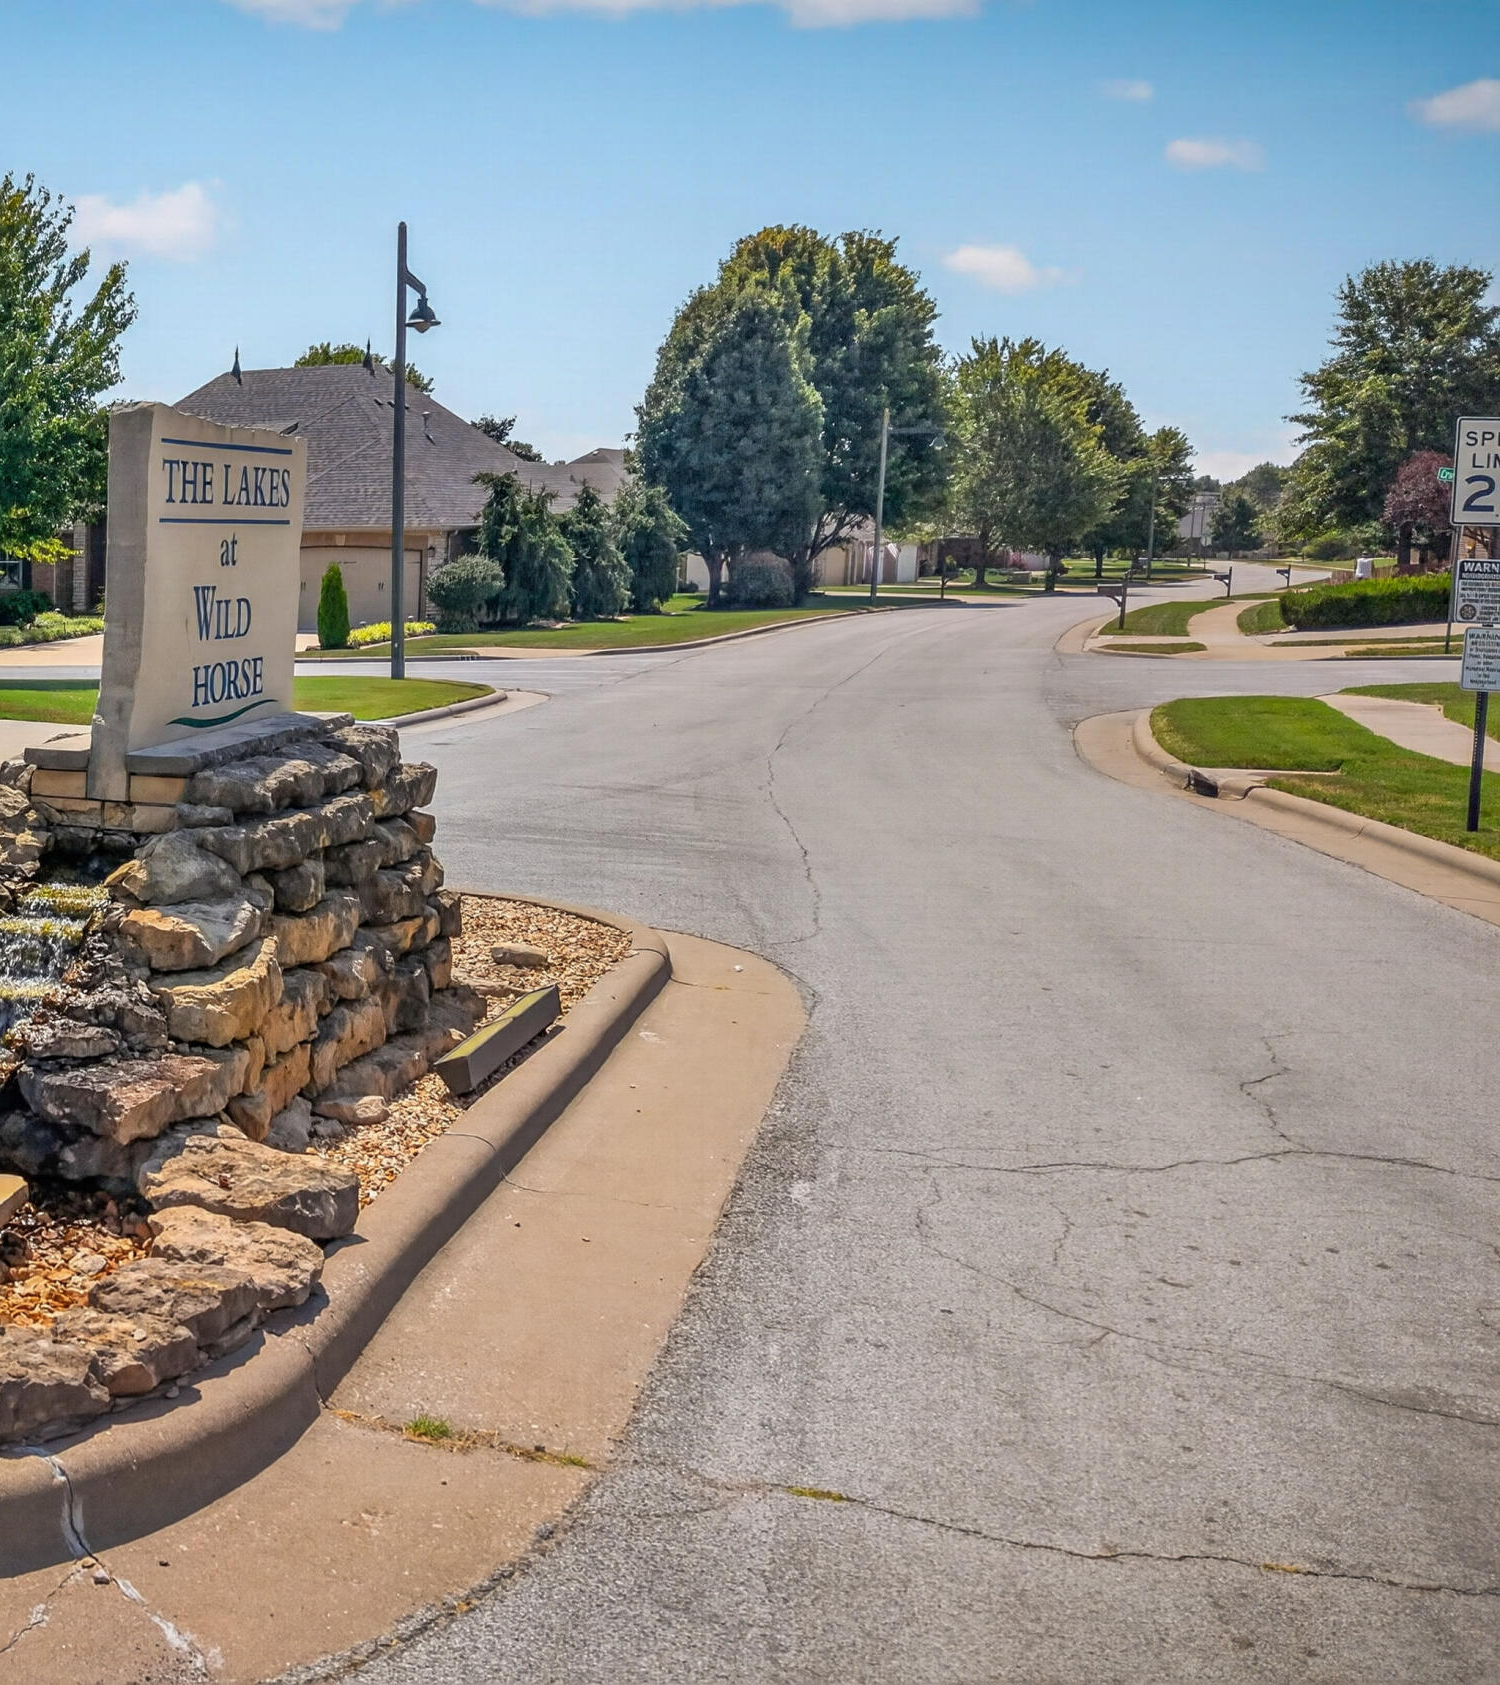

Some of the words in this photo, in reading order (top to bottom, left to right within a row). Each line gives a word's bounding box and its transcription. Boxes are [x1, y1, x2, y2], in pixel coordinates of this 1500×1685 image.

[1466, 431, 1500, 446] SP
[163, 458, 213, 504] THE
[222, 464, 291, 508] LAKES
[220, 533, 237, 567] at
[193, 585, 251, 641] WILD
[192, 656, 264, 707] HORSE
